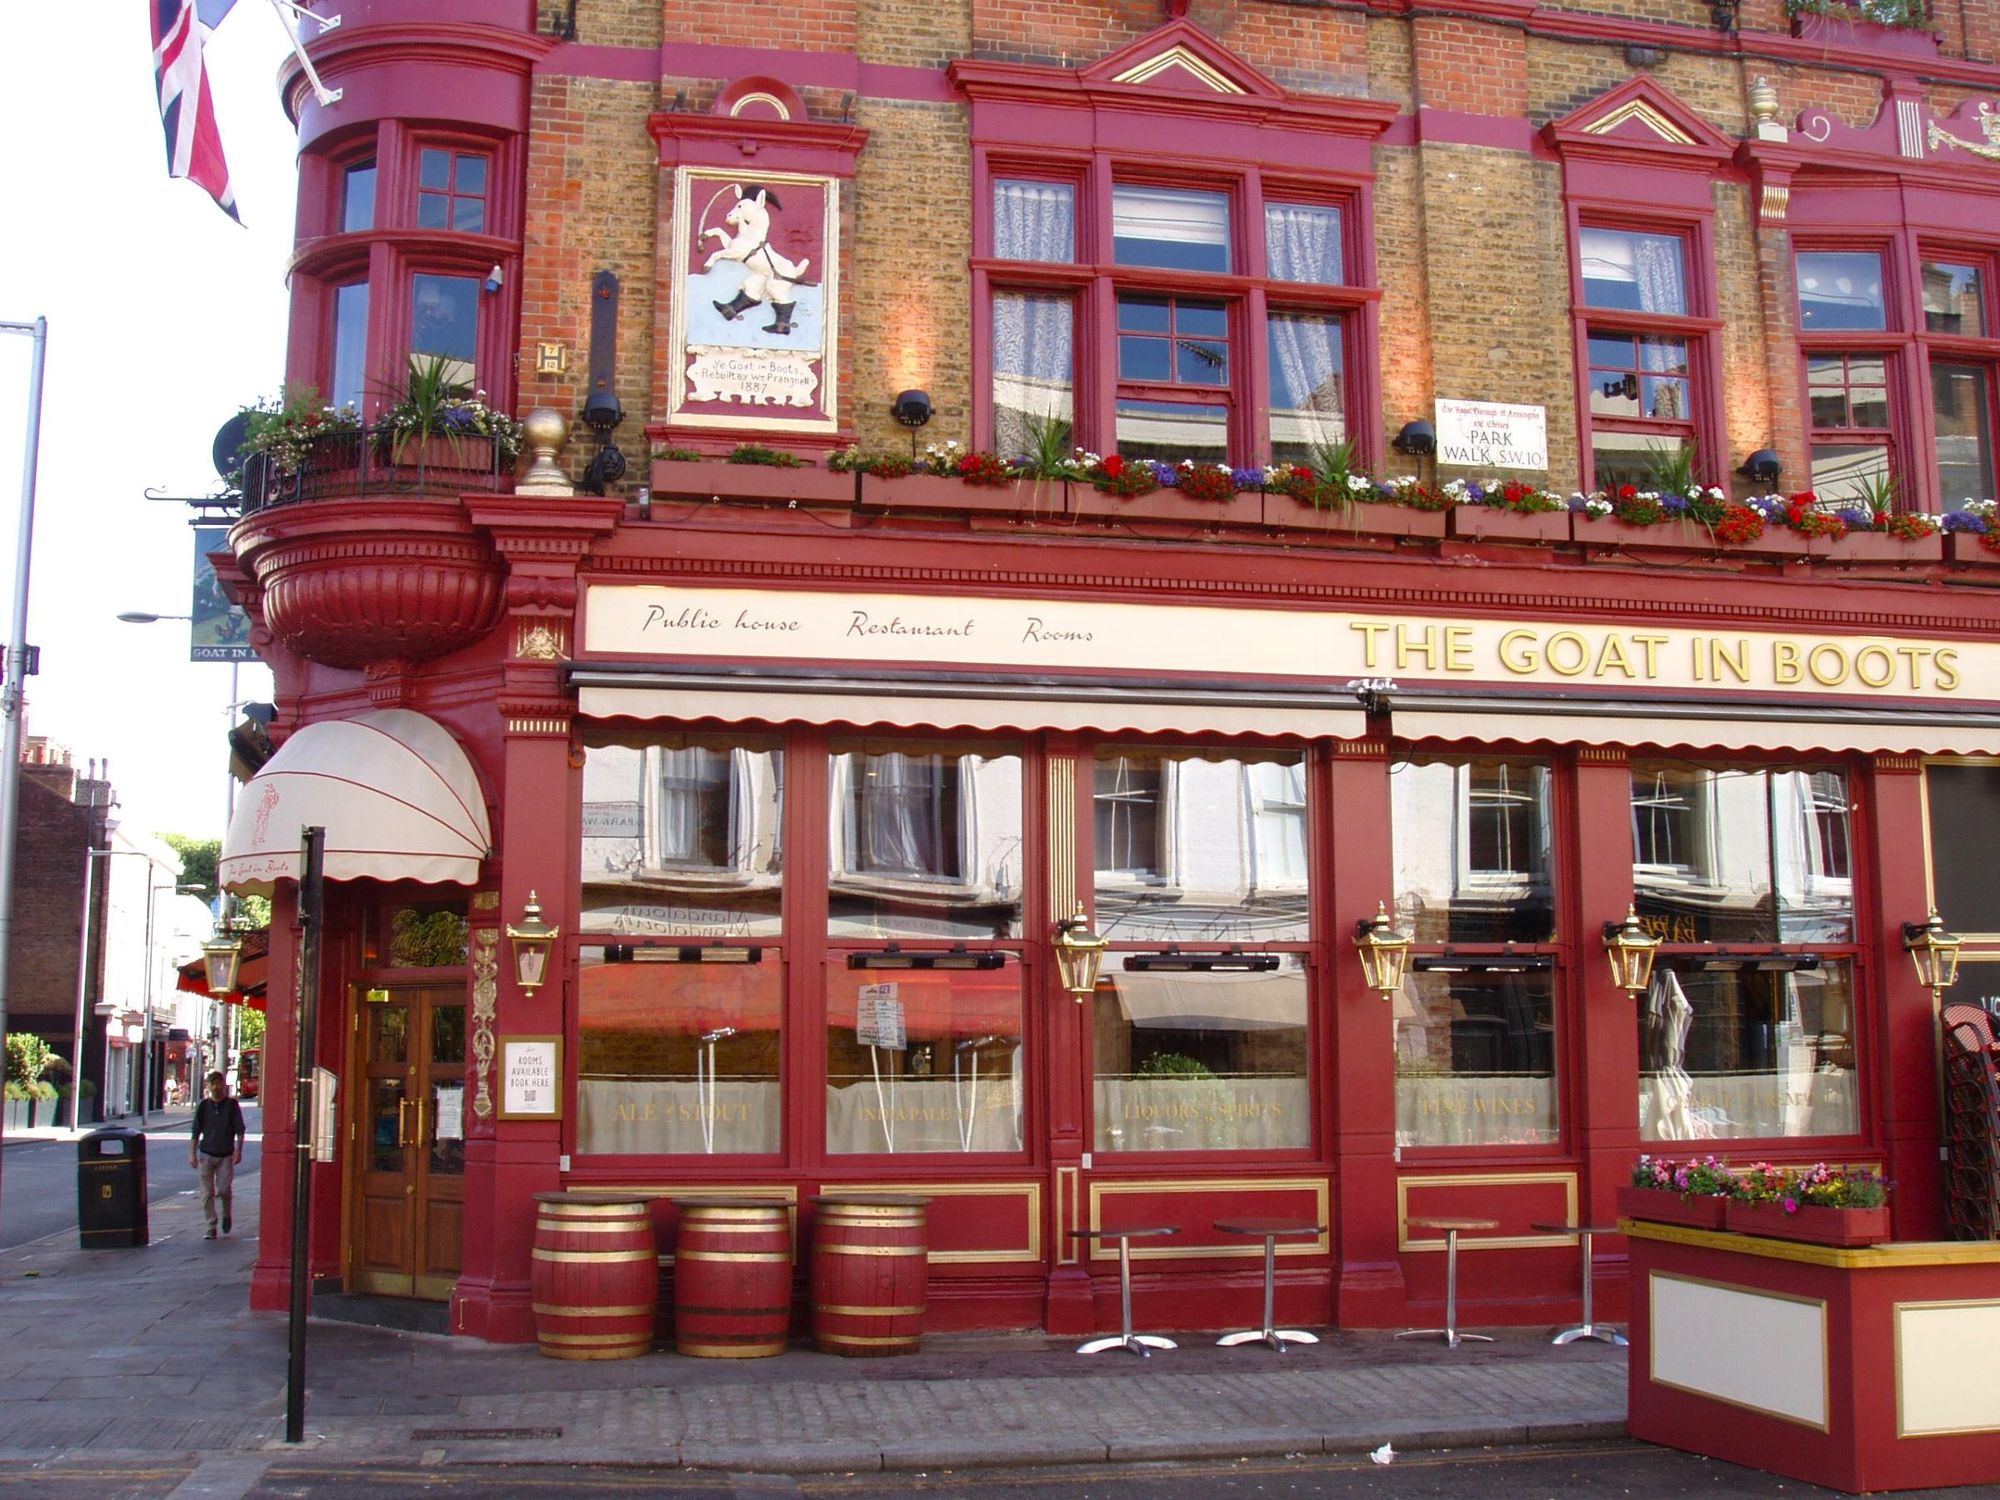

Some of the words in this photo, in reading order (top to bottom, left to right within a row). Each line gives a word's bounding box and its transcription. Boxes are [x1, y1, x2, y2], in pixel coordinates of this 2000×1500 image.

[728, 359, 753, 371] Goat
[740, 380, 768, 394] 1887
[1470, 430, 1513, 446] PARK
[1444, 446, 1490, 462] WALK
[641, 604, 723, 633] Public
[734, 609, 803, 633] house
[845, 610, 976, 640] Restaurant
[1021, 617, 1095, 645] Rooms
[192, 648, 228, 658] GOAT
[232, 648, 247, 658] IN
[1349, 620, 1475, 673] THE
[1498, 629, 1671, 679] GOAT
[1692, 636, 1752, 683] IN
[1772, 640, 1963, 691] BOOTS
[518, 1056, 543, 1065] ROOMS
[511, 1067, 550, 1077] AVAILABLE
[510, 1078, 529, 1088] BOOK
[531, 1078, 551, 1088] HERE
[616, 1103, 657, 1121] ALE
[910, 1106, 950, 1121] PALE
